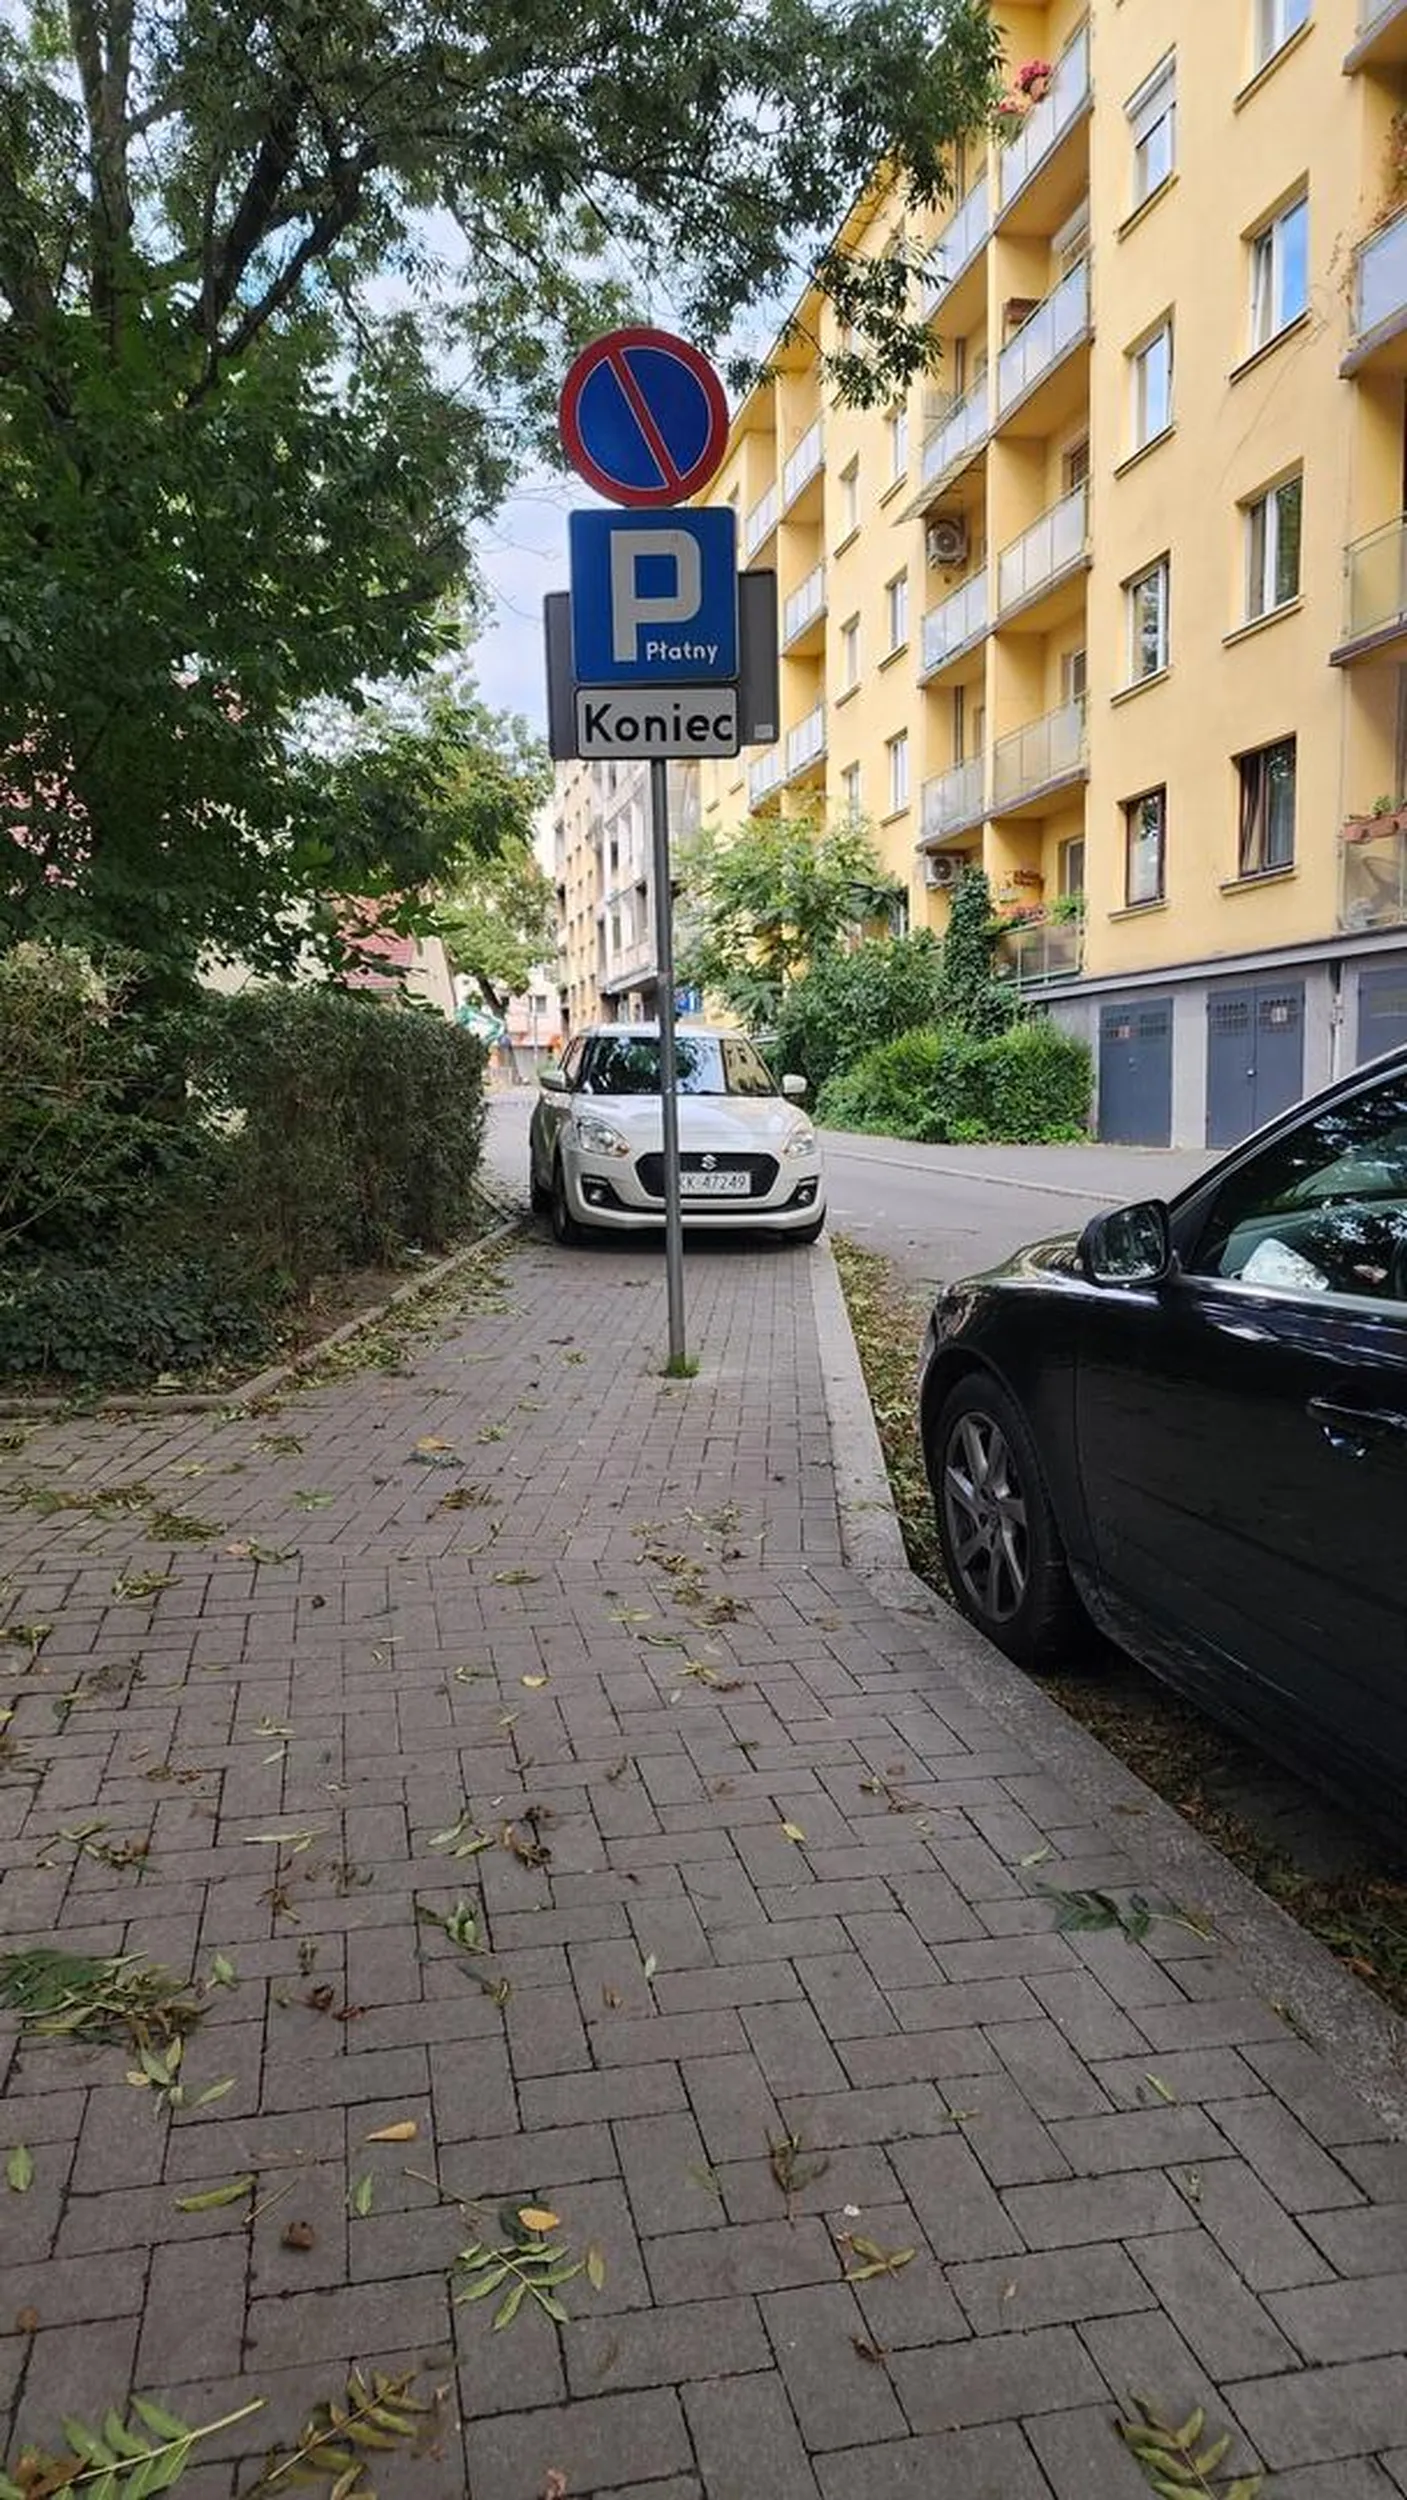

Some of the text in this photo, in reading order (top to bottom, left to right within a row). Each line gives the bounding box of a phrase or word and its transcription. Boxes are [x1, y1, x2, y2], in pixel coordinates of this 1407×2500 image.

[611, 530, 701, 663] P
[646, 641, 718, 665] Płatny
[584, 703, 733, 742] Koniec
